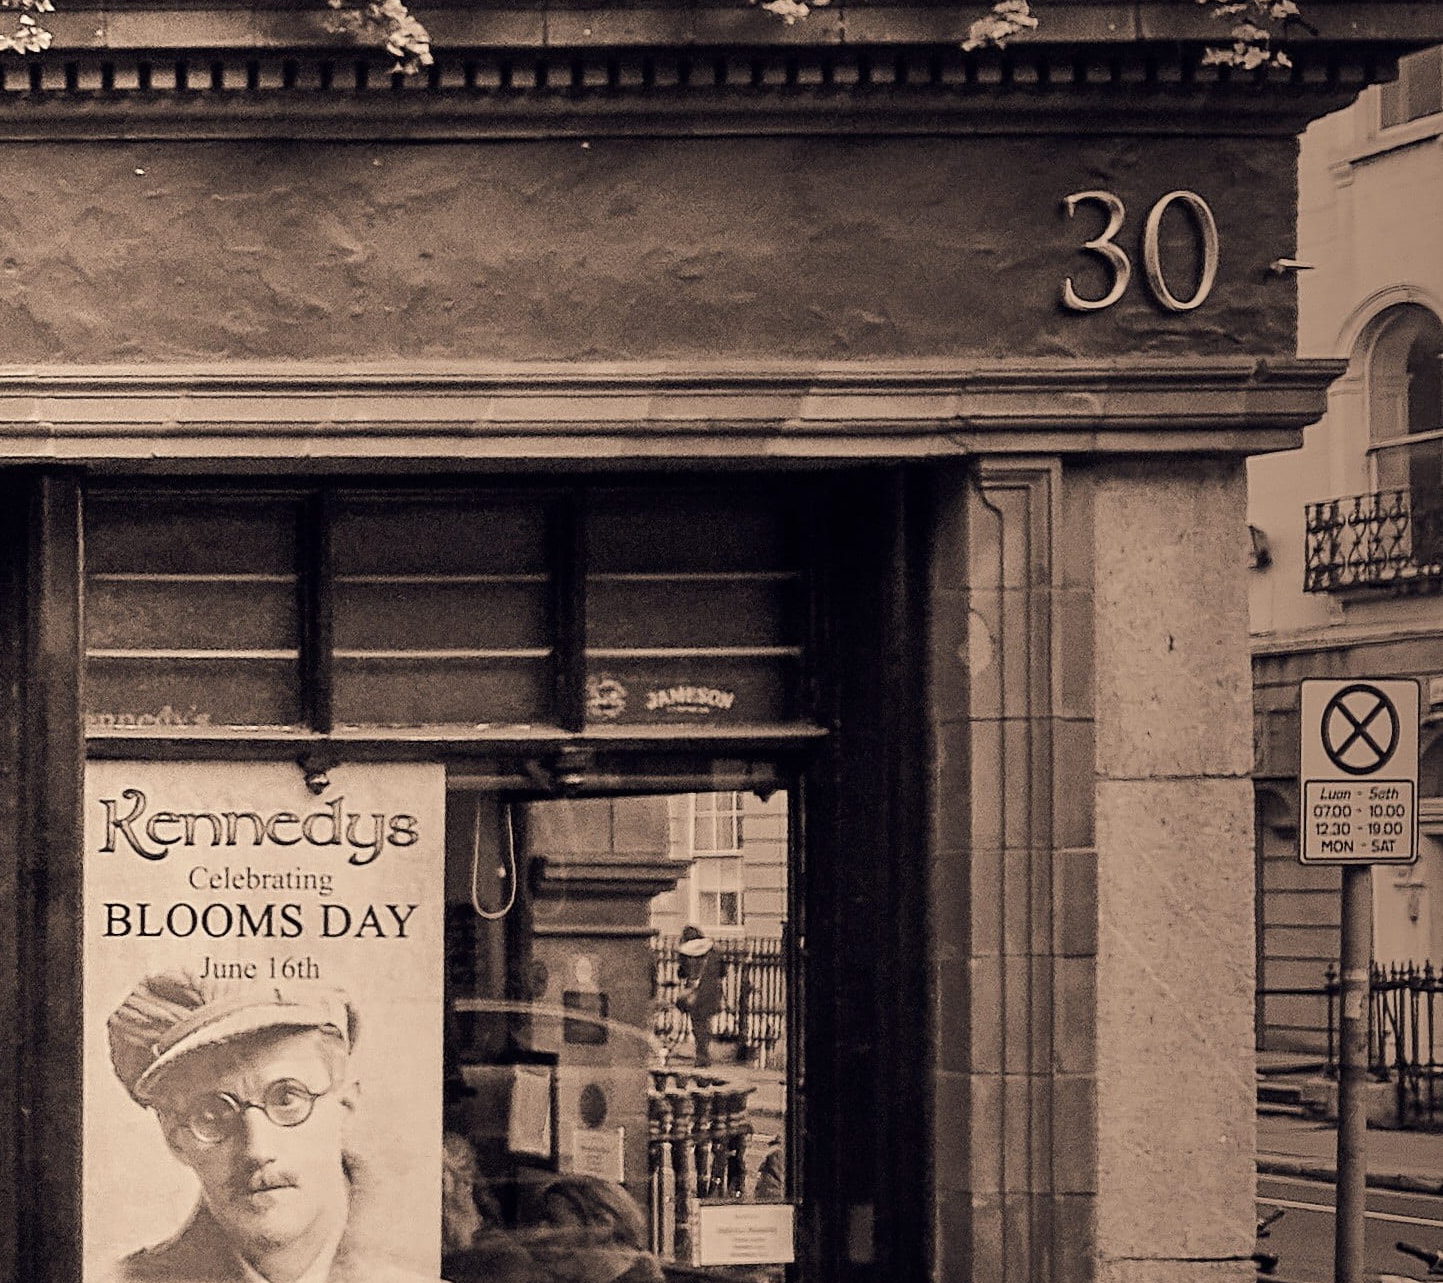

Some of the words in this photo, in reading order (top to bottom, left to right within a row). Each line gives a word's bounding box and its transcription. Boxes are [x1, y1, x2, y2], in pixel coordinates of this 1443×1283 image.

[1063, 190, 1219, 312] 30
[1320, 788, 1351, 800] Luan
[99, 788, 420, 866] Kennedys
[1321, 840, 1354, 853] MON
[1372, 840, 1396, 852] SAT
[189, 866, 334, 896] Celebrating
[102, 902, 303, 939] BLOOMS
[320, 903, 420, 939] DAY
[200, 956, 256, 980] June
[268, 955, 320, 979] 16th
